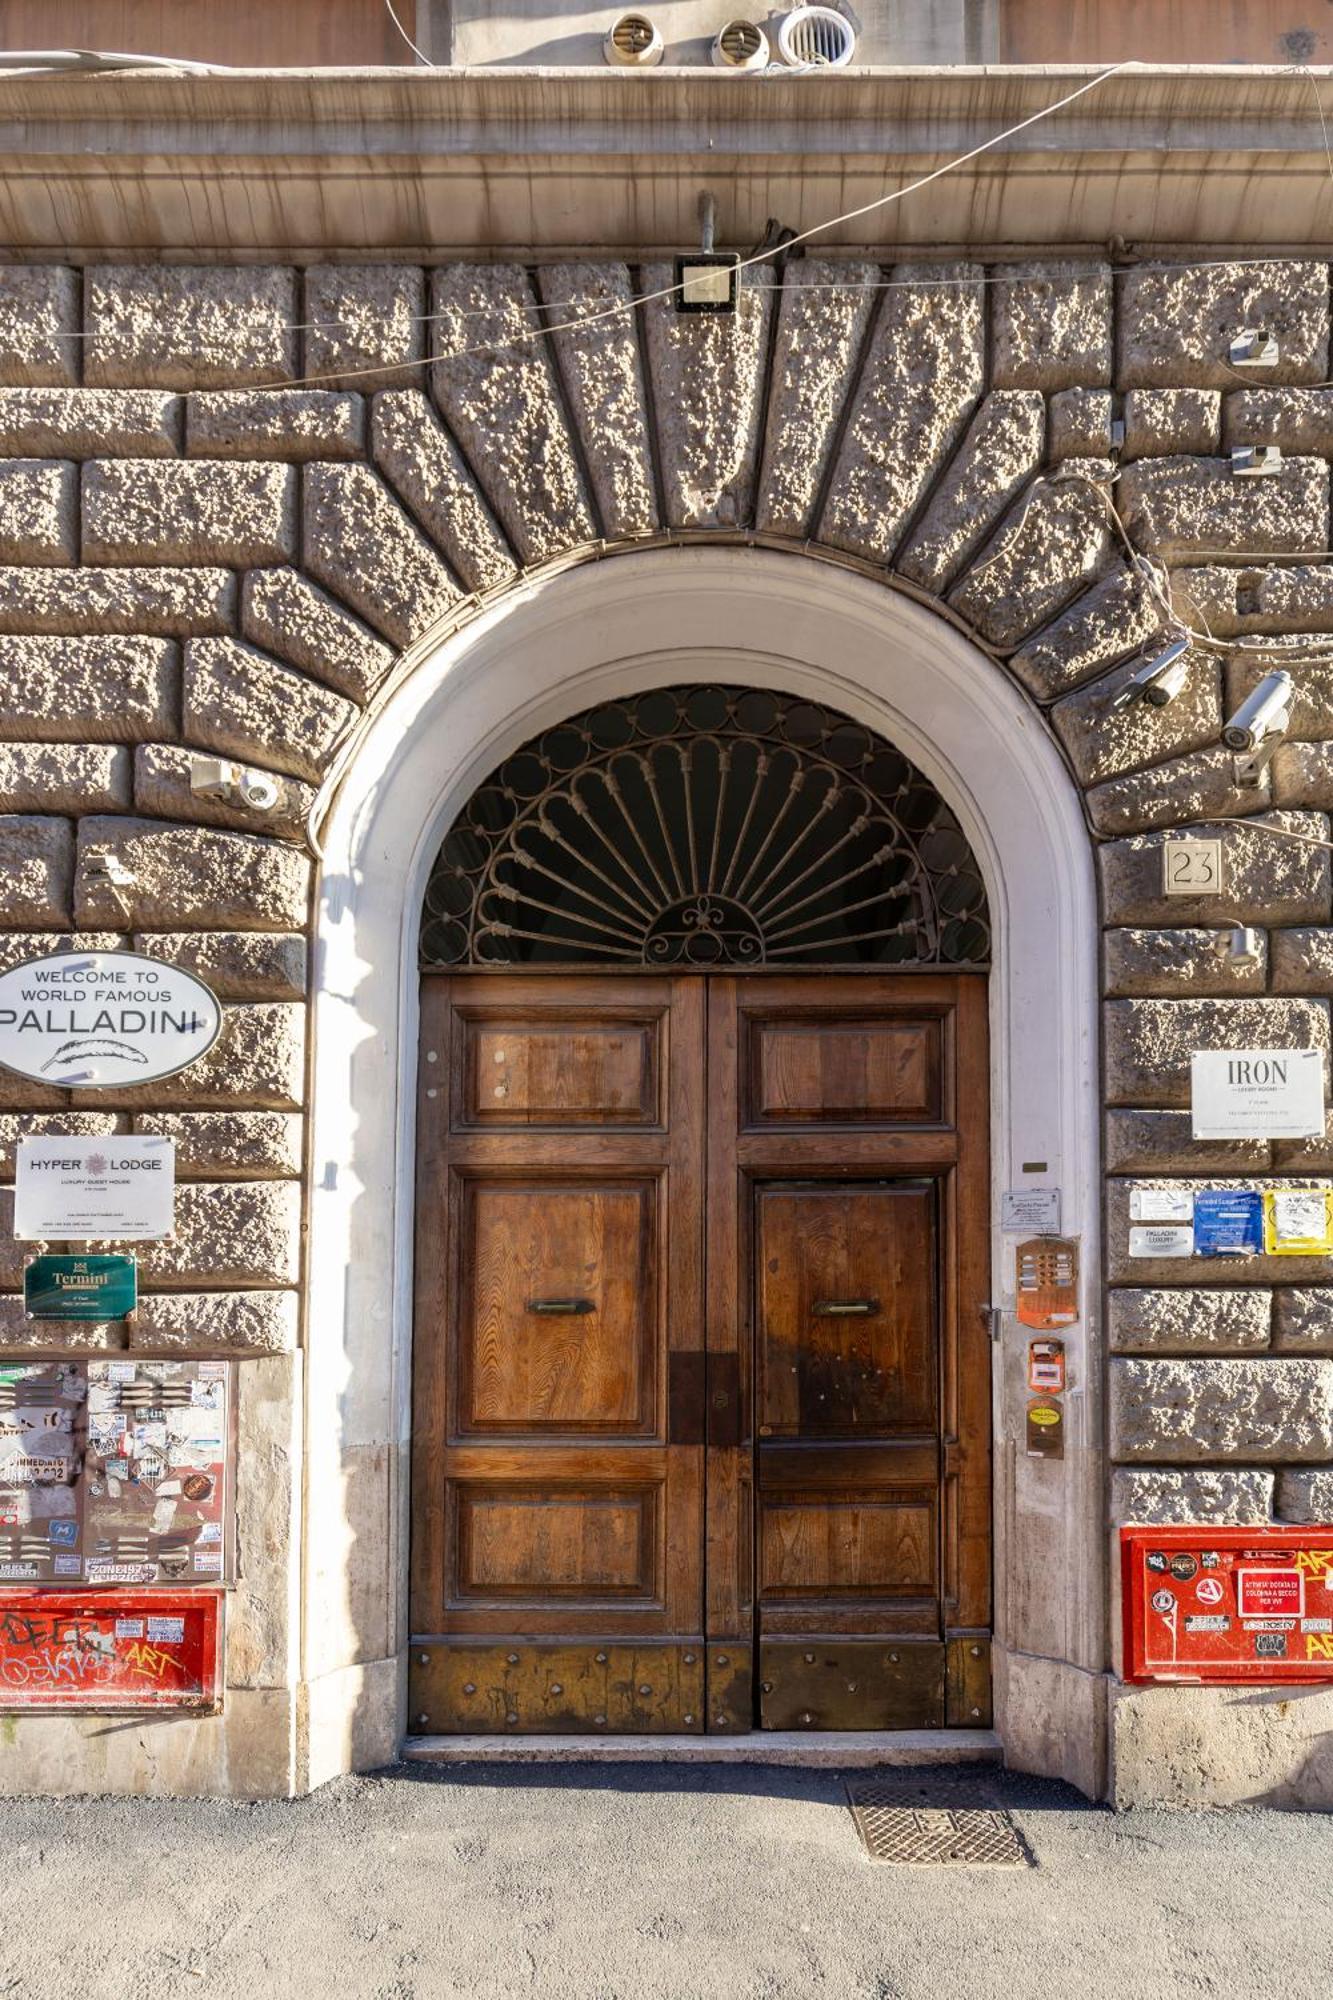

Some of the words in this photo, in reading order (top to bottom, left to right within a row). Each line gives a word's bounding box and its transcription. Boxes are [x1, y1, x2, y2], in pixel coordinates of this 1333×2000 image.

[1173, 851, 1213, 883] 23
[35, 971, 126, 984] WELCOME
[134, 971, 159, 984] TO
[21, 990, 86, 1001] WORLD
[95, 990, 172, 1002] FAMOUS
[0, 1010, 197, 1034] PALLADINI
[1228, 1060, 1288, 1084] IRON
[31, 1159, 82, 1170] HYPER
[111, 1159, 162, 1170] LODGE
[52, 1272, 109, 1285] Termini
[125, 1642, 184, 1677] ART
